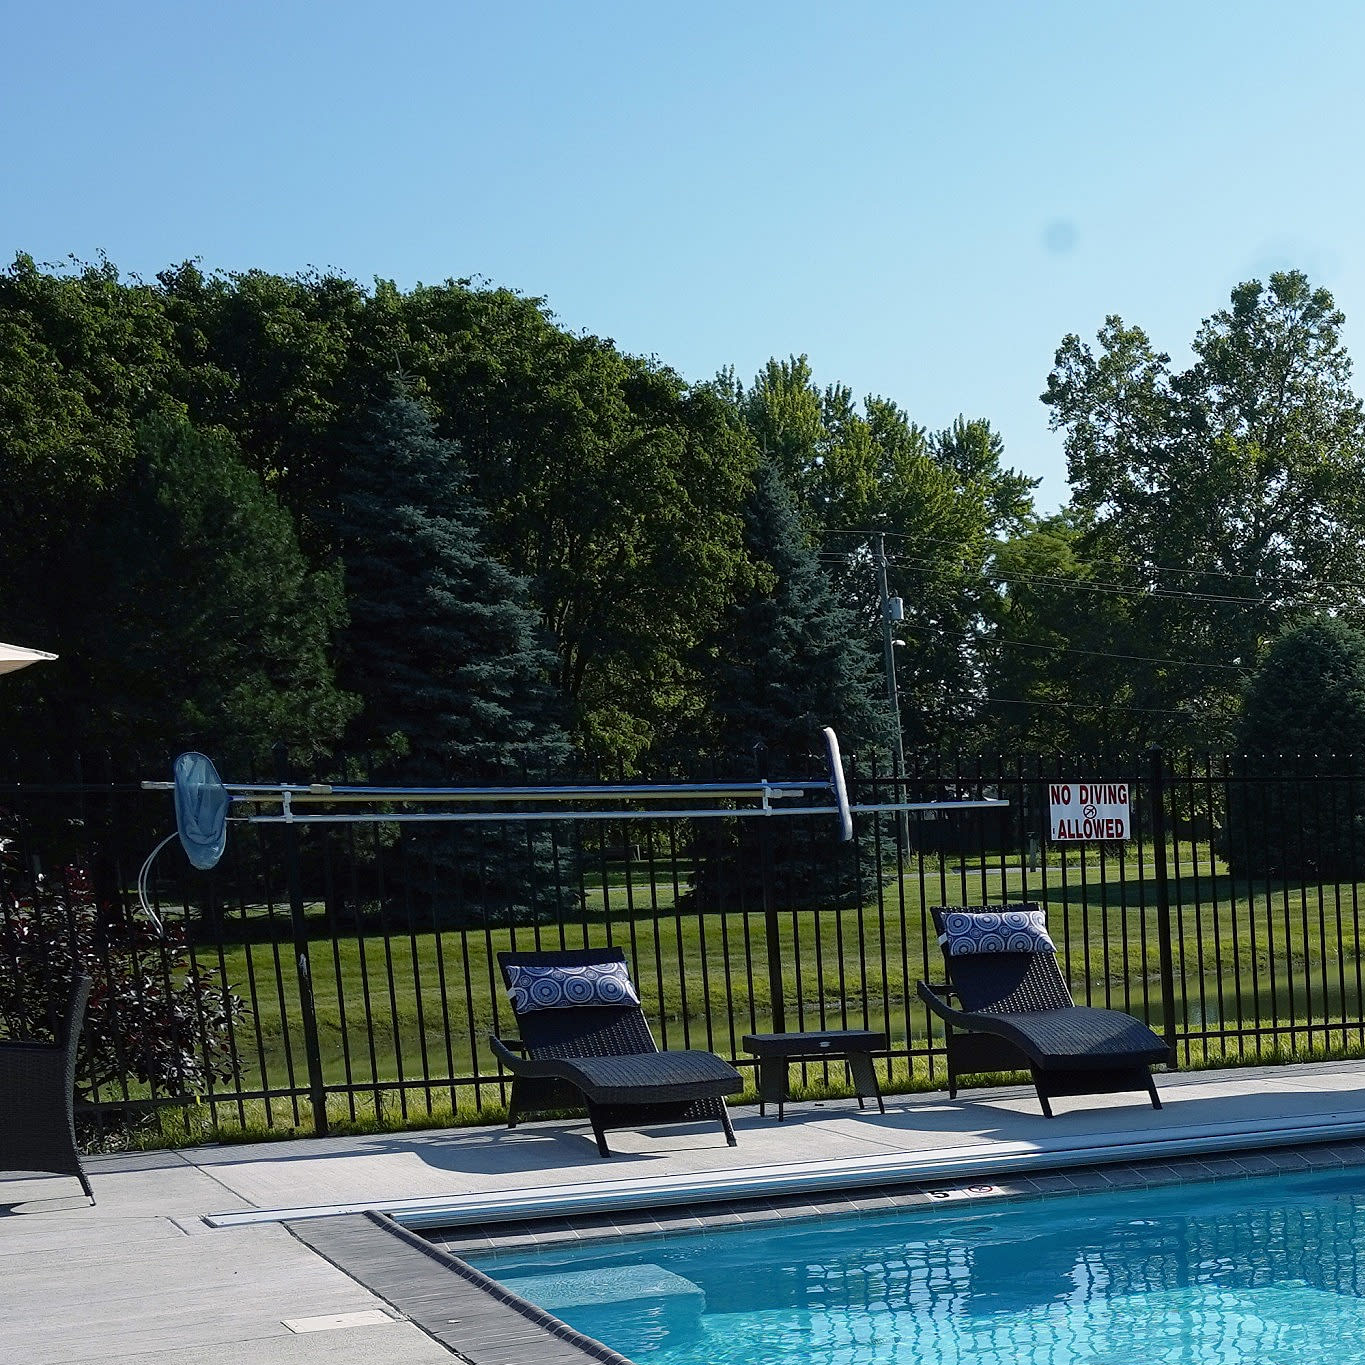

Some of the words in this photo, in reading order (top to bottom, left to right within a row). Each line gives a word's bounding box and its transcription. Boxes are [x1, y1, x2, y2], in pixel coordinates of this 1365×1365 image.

[1051, 785, 1071, 805] NO
[1080, 785, 1128, 805] DIVING
[1058, 819, 1124, 839] ALLOWED
